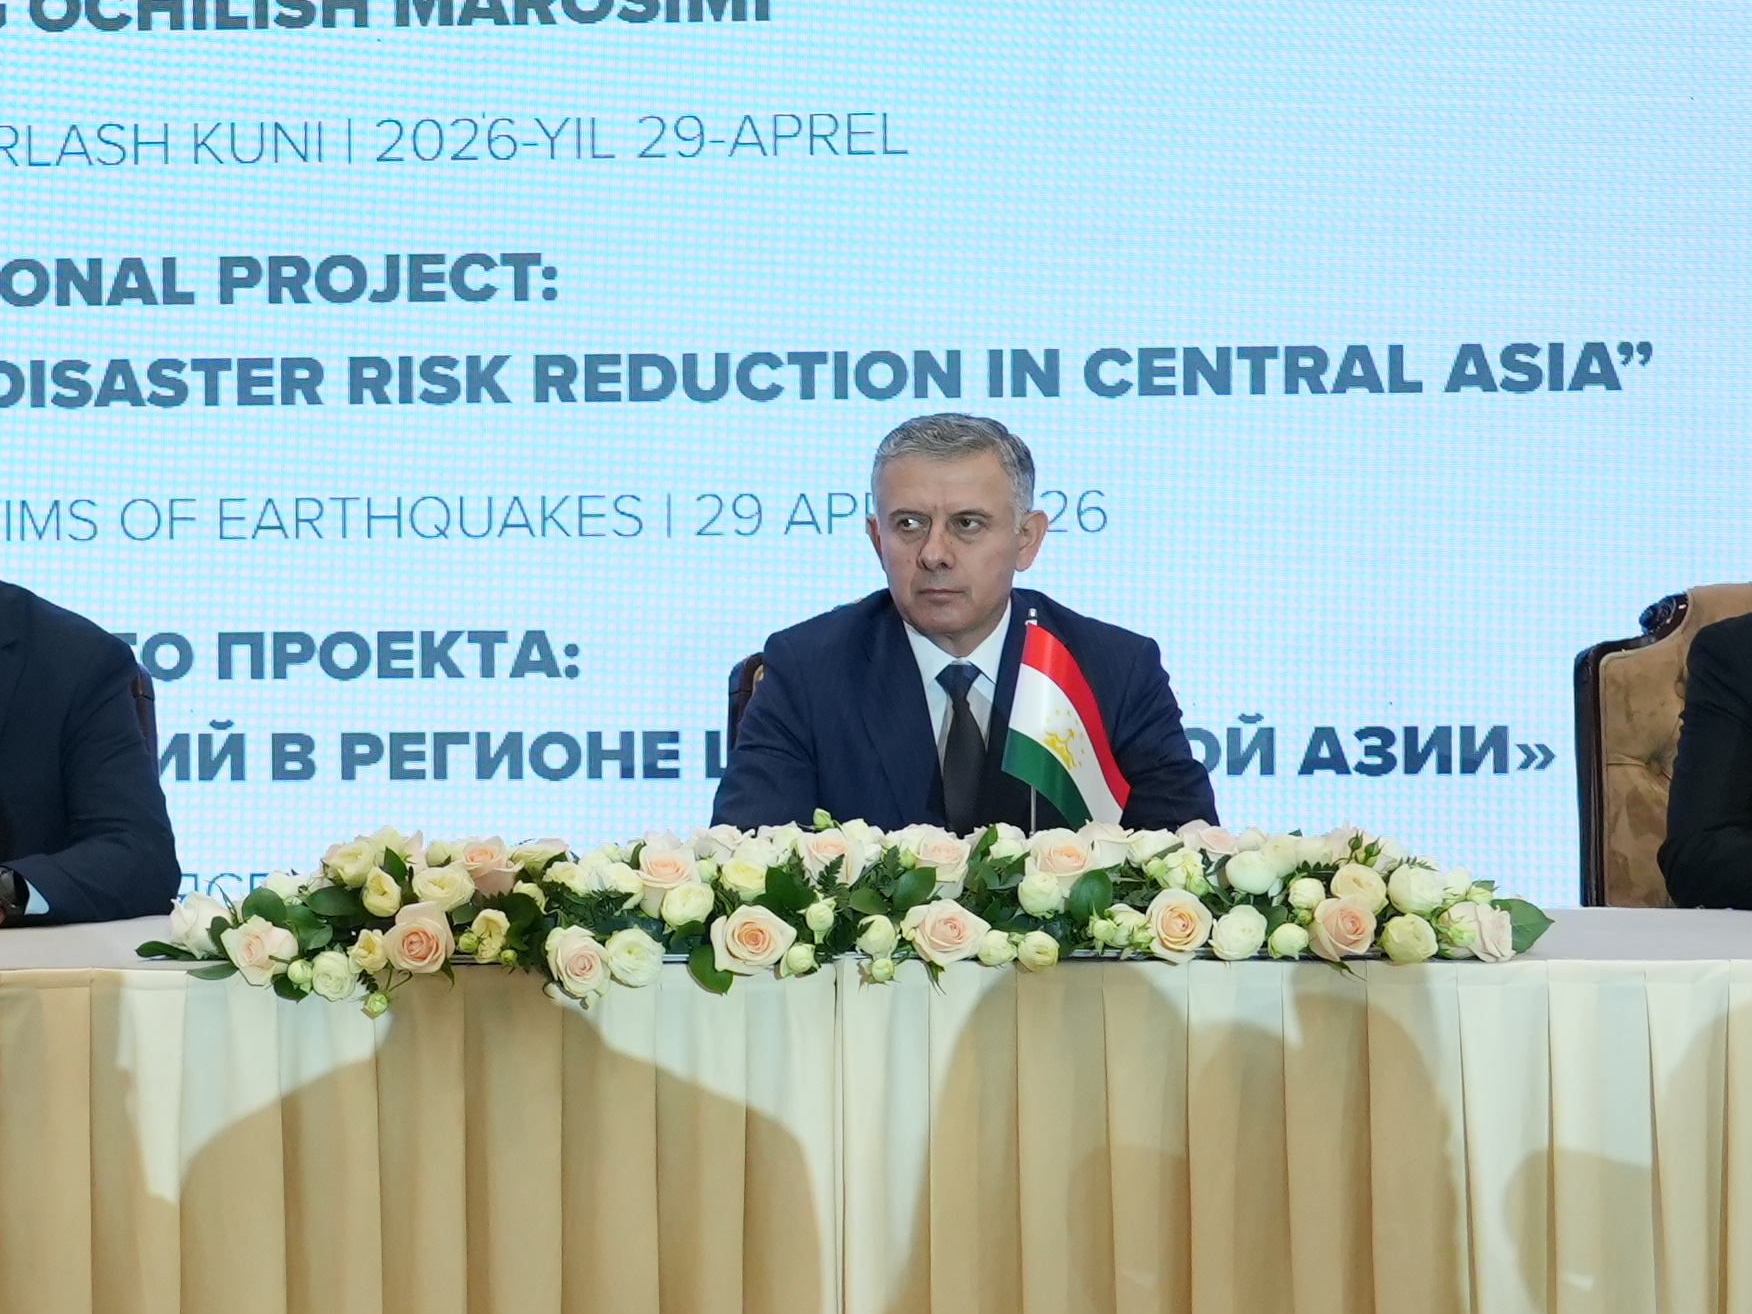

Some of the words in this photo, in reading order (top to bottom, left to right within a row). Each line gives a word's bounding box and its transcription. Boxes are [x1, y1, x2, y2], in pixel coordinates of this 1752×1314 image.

[191, 120, 325, 166] KUNI
[373, 115, 614, 164] 2026-YIL
[637, 110, 910, 160] 29-APREL
[219, 253, 557, 305] PROJECT:
[348, 355, 510, 405] RISK
[534, 349, 961, 403] REDUCTION
[988, 349, 1060, 398] IN
[1084, 344, 1423, 399] CENTRAL
[118, 497, 196, 542] OF
[217, 494, 644, 541] EARTHQUAKES
[695, 492, 764, 537] 29
[218, 630, 583, 681] ПРОЕКТА:
[272, 732, 316, 781] В
[341, 731, 681, 781] РЕГИОНЕ
